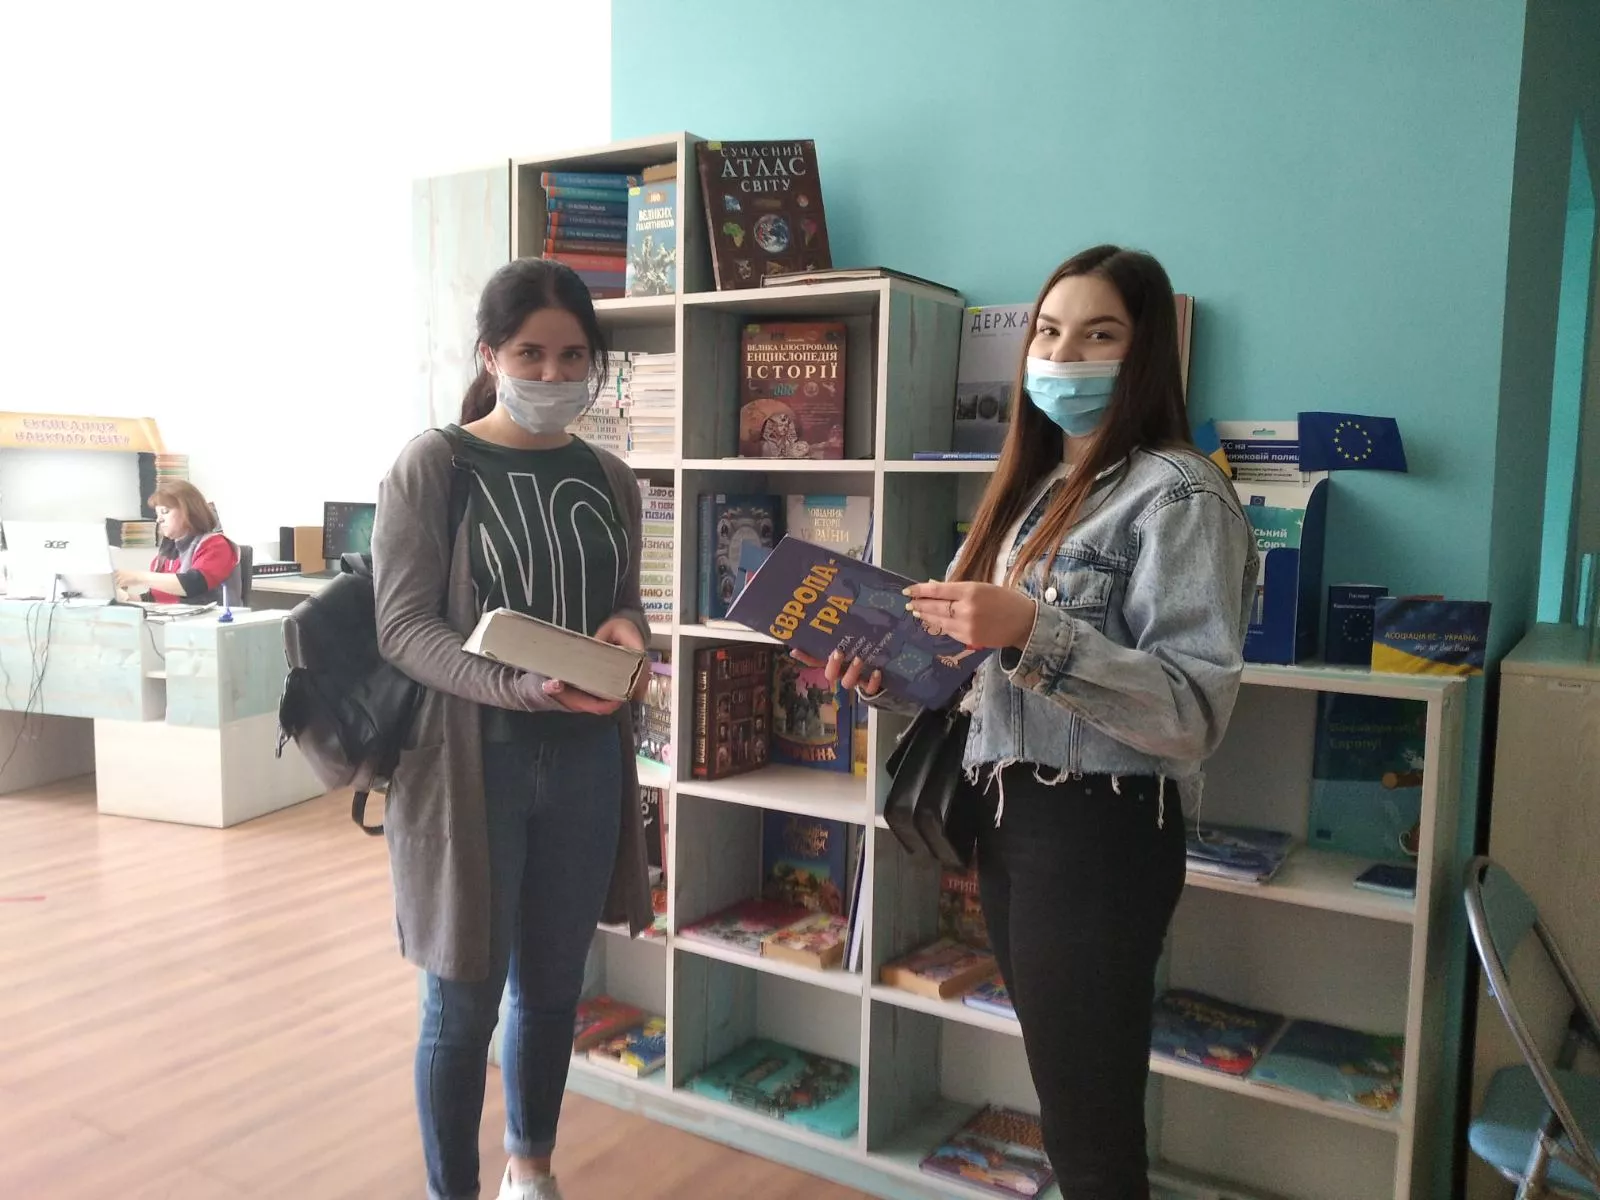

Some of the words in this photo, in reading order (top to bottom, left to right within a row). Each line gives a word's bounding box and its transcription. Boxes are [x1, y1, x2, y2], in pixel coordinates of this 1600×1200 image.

[720, 143, 804, 157] СУЧАСНИЙ
[721, 156, 807, 178] АТЛАС
[740, 179, 791, 193] СВІТУ
[971, 311, 1030, 333] ДЕРЖА
[747, 344, 779, 352] ВЕЛИКА
[746, 351, 838, 363] ЕНЦИКЛОПЕДІЯ
[746, 362, 838, 379] ІСТОРІЇ
[1251, 527, 1288, 539] ський
[43, 539, 70, 549] acer
[808, 595, 854, 635] ГРА
